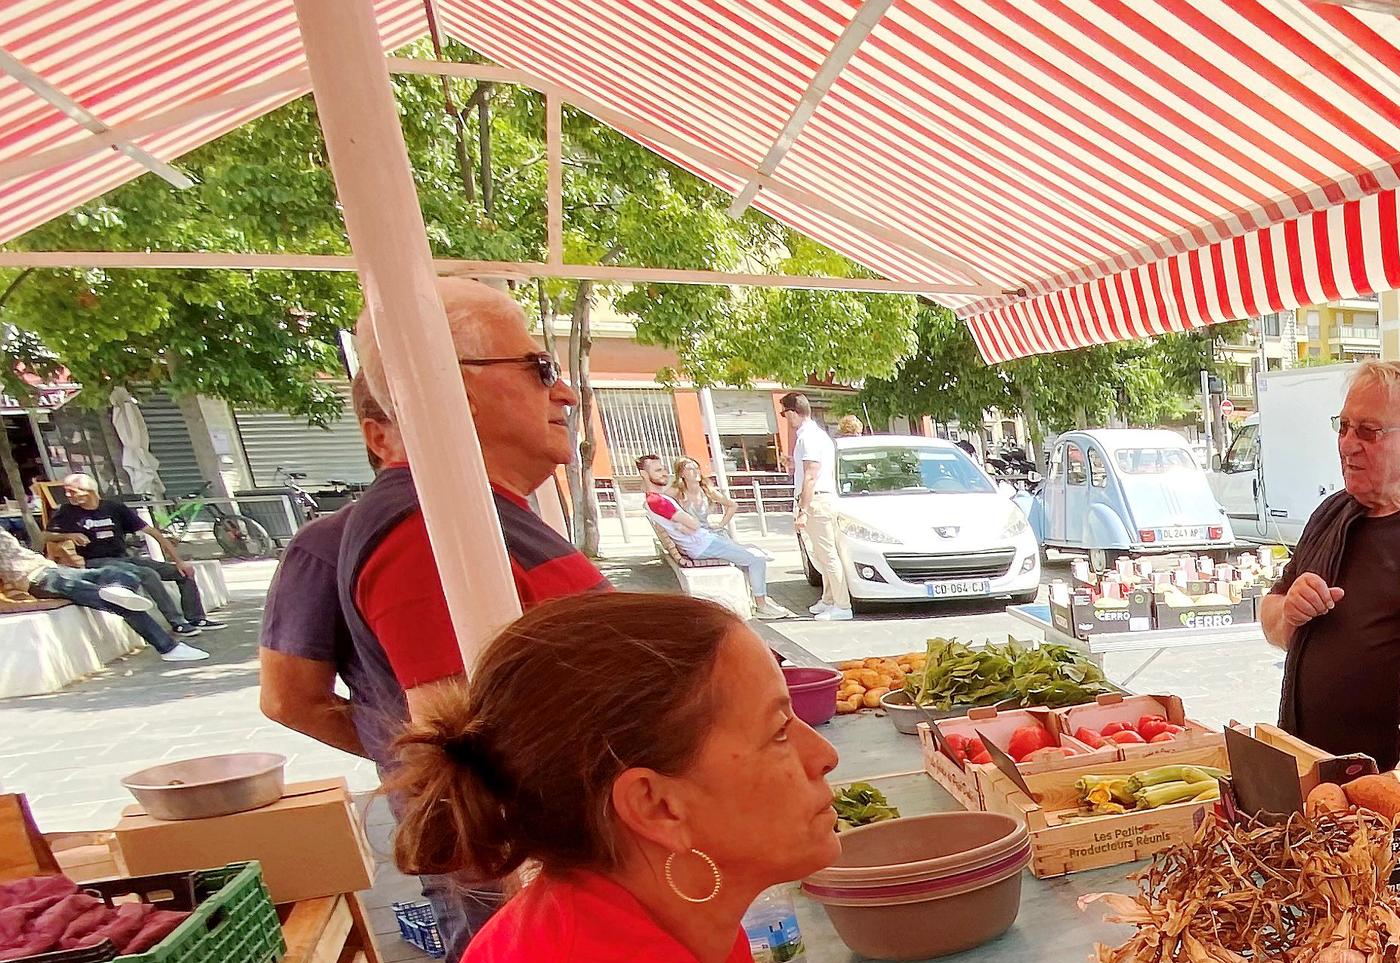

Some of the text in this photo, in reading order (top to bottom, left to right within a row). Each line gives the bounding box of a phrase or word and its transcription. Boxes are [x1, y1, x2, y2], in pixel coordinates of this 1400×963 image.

[1098, 611, 1131, 621] CERRO
[1186, 614, 1233, 628] CERRO
[1094, 825, 1144, 842] Les Petits
[1069, 831, 1171, 858] Producteurs Réunis
